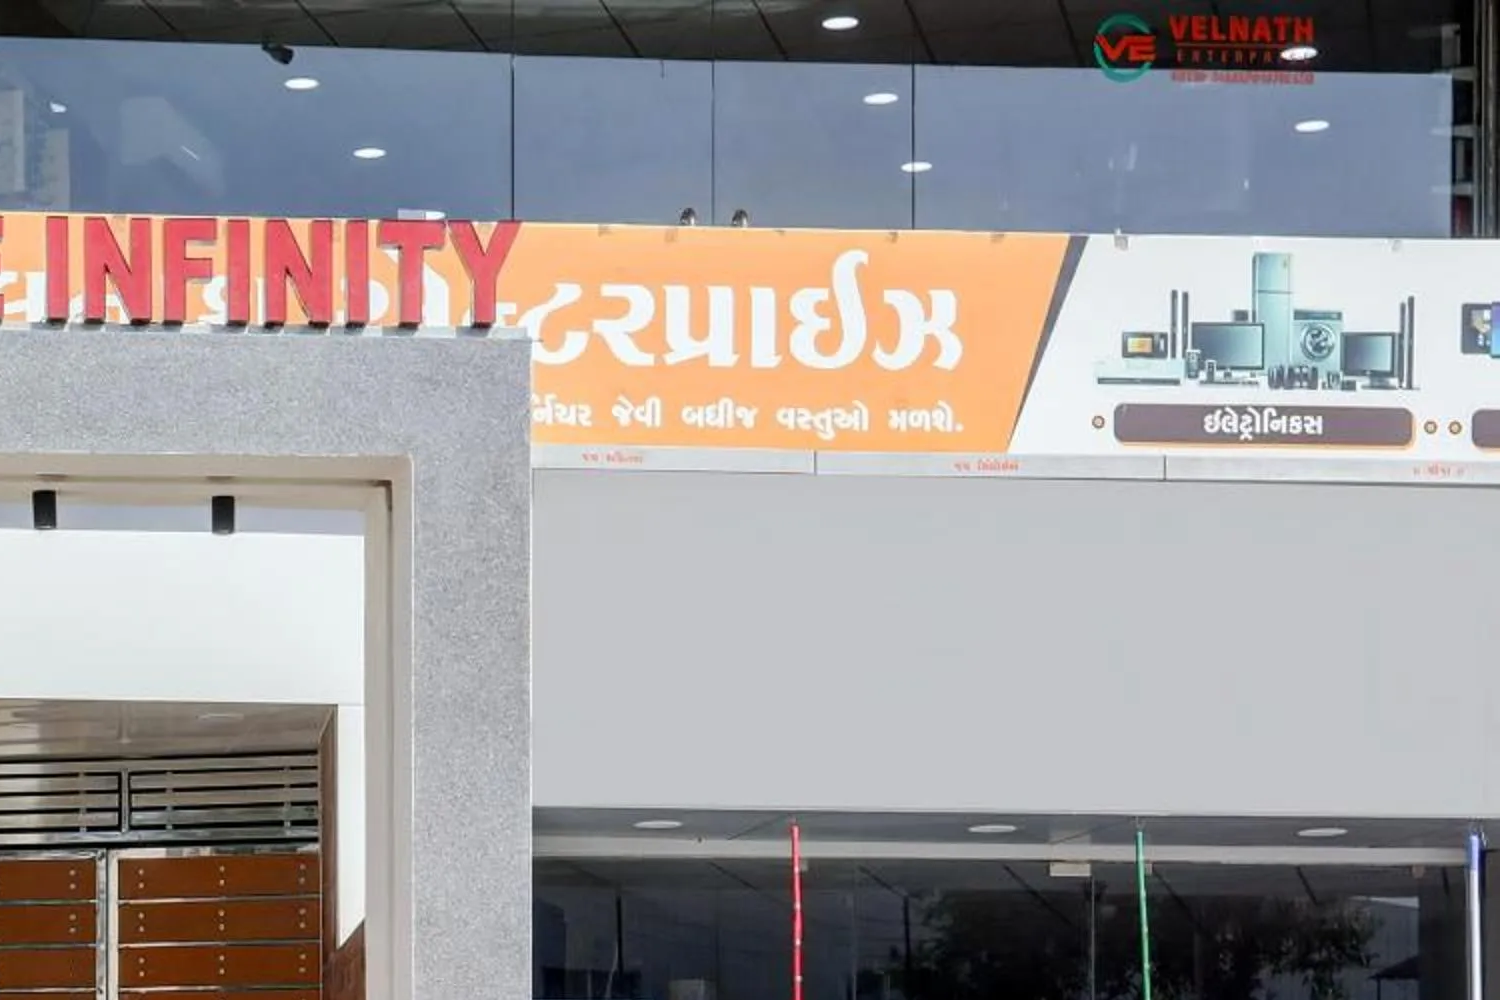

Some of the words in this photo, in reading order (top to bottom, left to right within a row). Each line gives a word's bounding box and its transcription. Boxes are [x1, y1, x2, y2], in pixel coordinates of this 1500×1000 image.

[1169, 15, 1315, 42] VELNATH
[1095, 34, 1157, 62] VE
[1177, 49, 1314, 64] ENTERPR
[46, 216, 522, 331] INFINITY
[532, 393, 593, 427] ર્નિચર
[611, 396, 662, 428] જેવી
[776, 399, 870, 440] વસ્તુઓ
[888, 399, 964, 432] મળશે.
